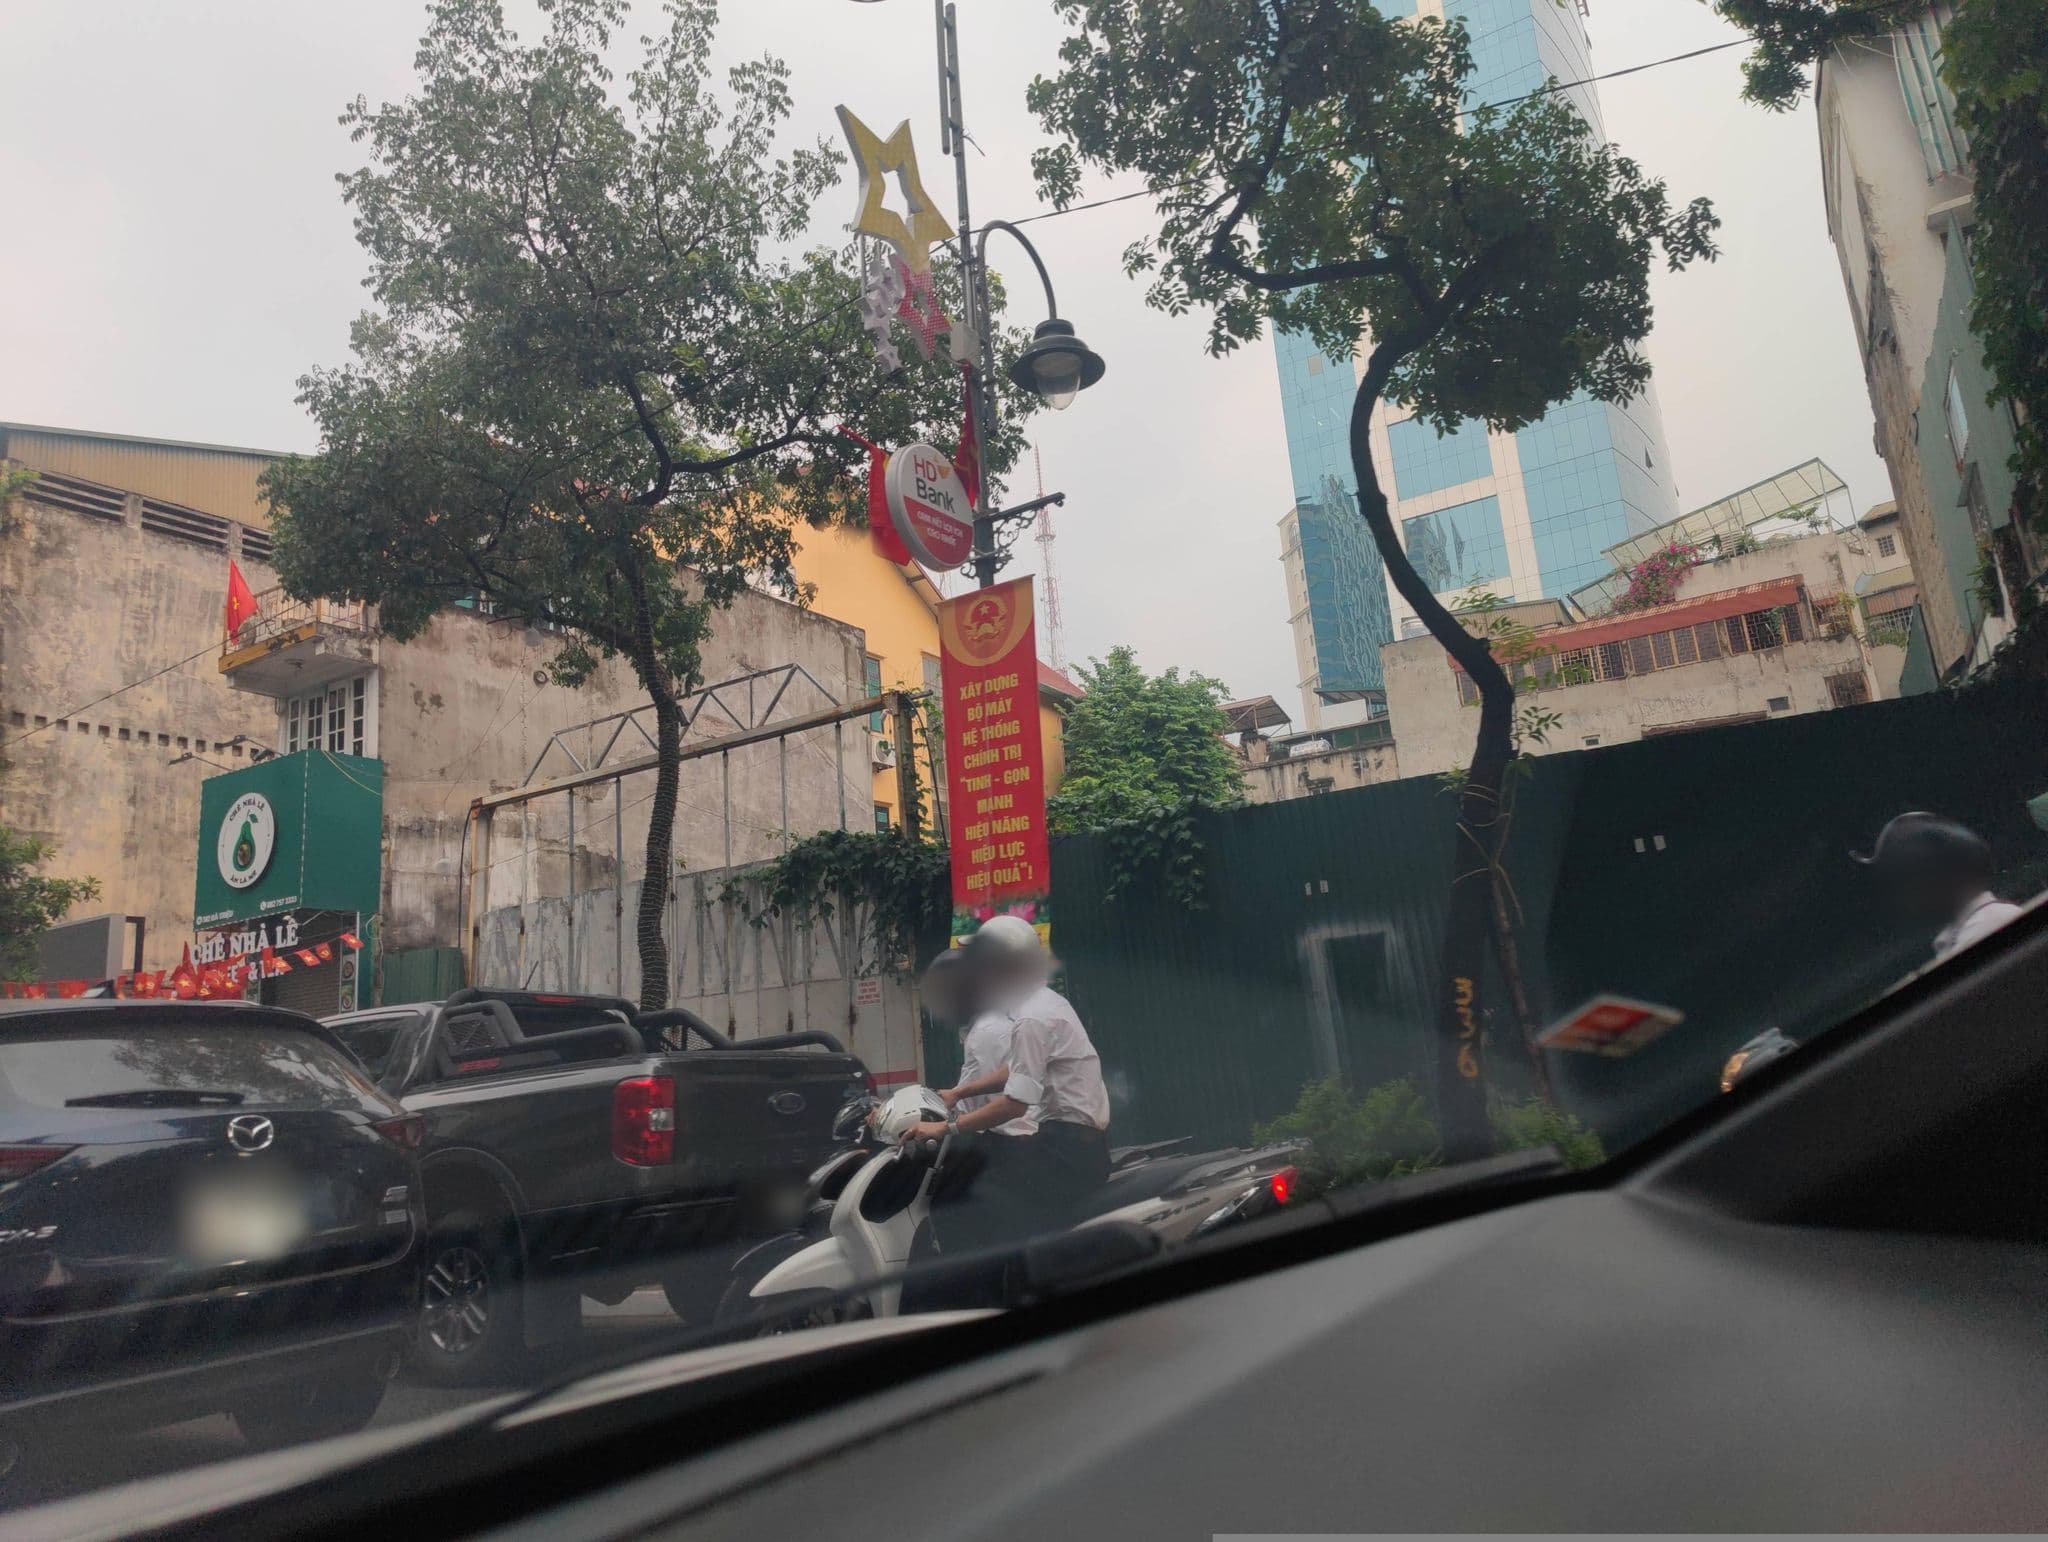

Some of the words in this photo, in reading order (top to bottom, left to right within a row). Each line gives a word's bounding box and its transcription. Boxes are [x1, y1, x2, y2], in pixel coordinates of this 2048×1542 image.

[913, 455, 937, 482] HD
[916, 478, 956, 513] Bank
[960, 682, 982, 700] XÂY
[985, 673, 1018, 694] DỰNG
[967, 703, 983, 721] BỘ
[985, 698, 1012, 716] MÁY
[962, 728, 978, 746] HỆ
[981, 719, 1020, 741] THỐNG
[964, 748, 1000, 769] CHÍNH
[1003, 744, 1022, 760] TRỊ
[977, 794, 1013, 814] MẠNH
[965, 822, 989, 841] HIỆU
[992, 815, 1030, 834] NĂNG
[971, 844, 995, 864] HIỆU
[999, 841, 1025, 860] LỰC
[967, 871, 991, 890] HIỆU
[230, 923, 268, 956] NHÀ
[275, 919, 299, 949] LÊ
